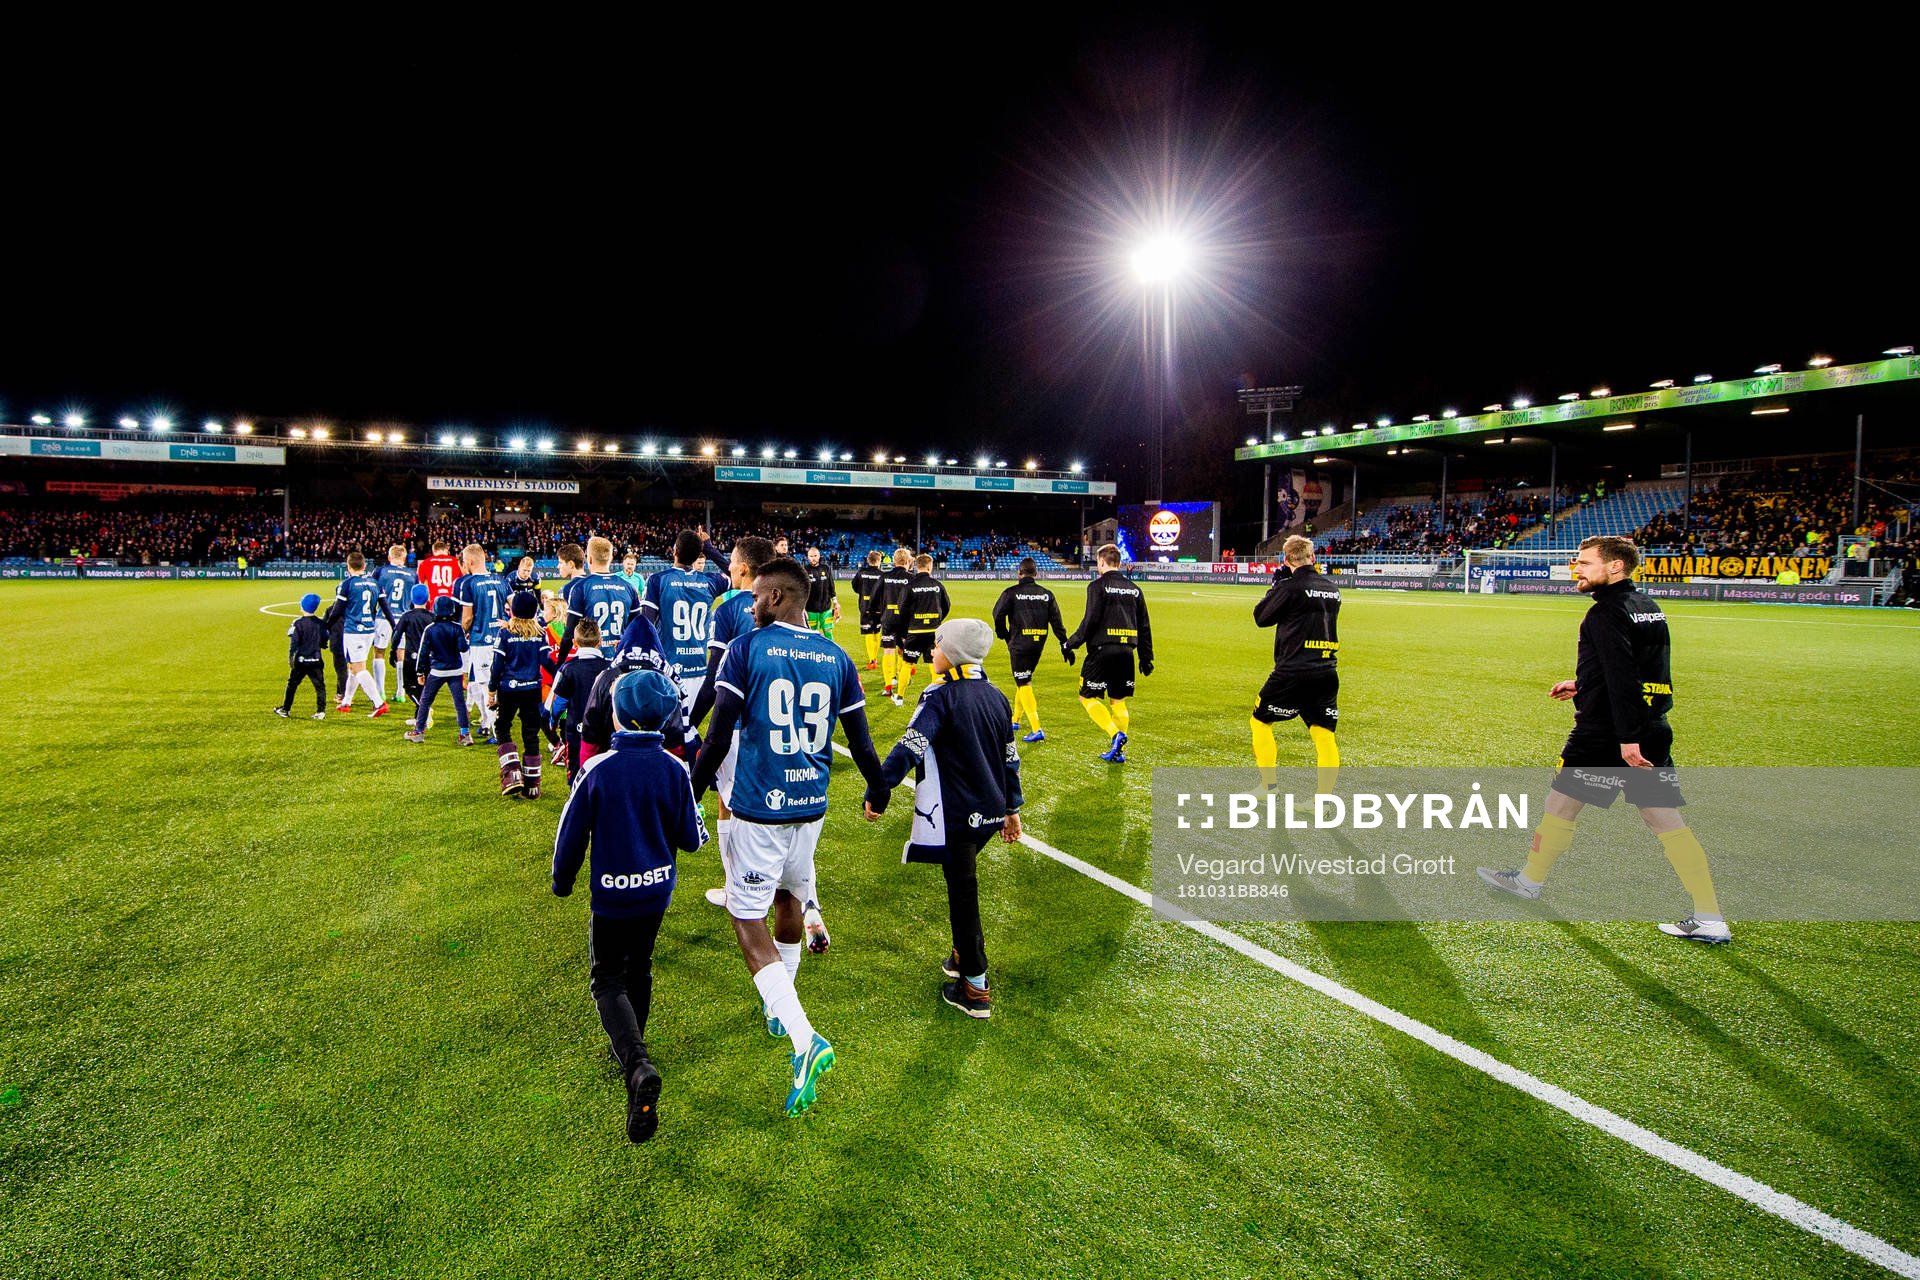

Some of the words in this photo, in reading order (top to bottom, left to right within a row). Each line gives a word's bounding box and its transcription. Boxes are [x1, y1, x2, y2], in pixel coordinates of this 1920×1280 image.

[1743, 377, 1782, 396] KIWI
[1609, 396, 1643, 412] KIWI
[1501, 411, 1528, 426] KIWI
[42, 442, 61, 453] DNB
[181, 448, 198, 458] DNB
[721, 470, 734, 478] DNB
[814, 474, 825, 482] DNB
[444, 479, 519, 490] MARIENLYST
[525, 480, 576, 492] STADION
[135, 570, 155, 579] gode
[156, 570, 171, 579] tips
[258, 570, 291, 578] Massevis
[302, 570, 321, 579] gode
[322, 570, 335, 579] tips
[1227, 564, 1236, 573] AS
[1483, 569, 1511, 577] NOPEK
[1645, 556, 1719, 578] KANARI
[1745, 557, 1832, 579] FANSEN
[432, 566, 453, 587] 40
[392, 579, 405, 601] 3
[1355, 580, 1381, 588] Massevis
[1393, 581, 1409, 591] gode
[1411, 581, 1423, 591] tips
[1509, 583, 1545, 592] Massevis
[1547, 585, 1558, 593] av
[1560, 583, 1579, 596] god
[1648, 588, 1667, 596] Barn
[1669, 588, 1681, 596] fra
[1683, 589, 1690, 597] A
[1702, 587, 1709, 597] Å
[362, 590, 372, 614] 2
[1723, 589, 1777, 600] Massevis
[1779, 591, 1796, 600] av
[1799, 591, 1831, 604] gode
[1834, 592, 1861, 604] tips
[488, 590, 497, 618] 7
[594, 601, 625, 637] 23
[673, 600, 708, 641] 90
[1120, 636, 1128, 644] SK
[768, 647, 787, 658] ekte
[789, 649, 836, 664] kjærlighet
[1321, 650, 1331, 658] SK
[769, 677, 831, 755] 93
[1573, 769, 1626, 788] Scandic
[787, 797, 808, 807] Redd
[601, 864, 672, 889] GODSET
